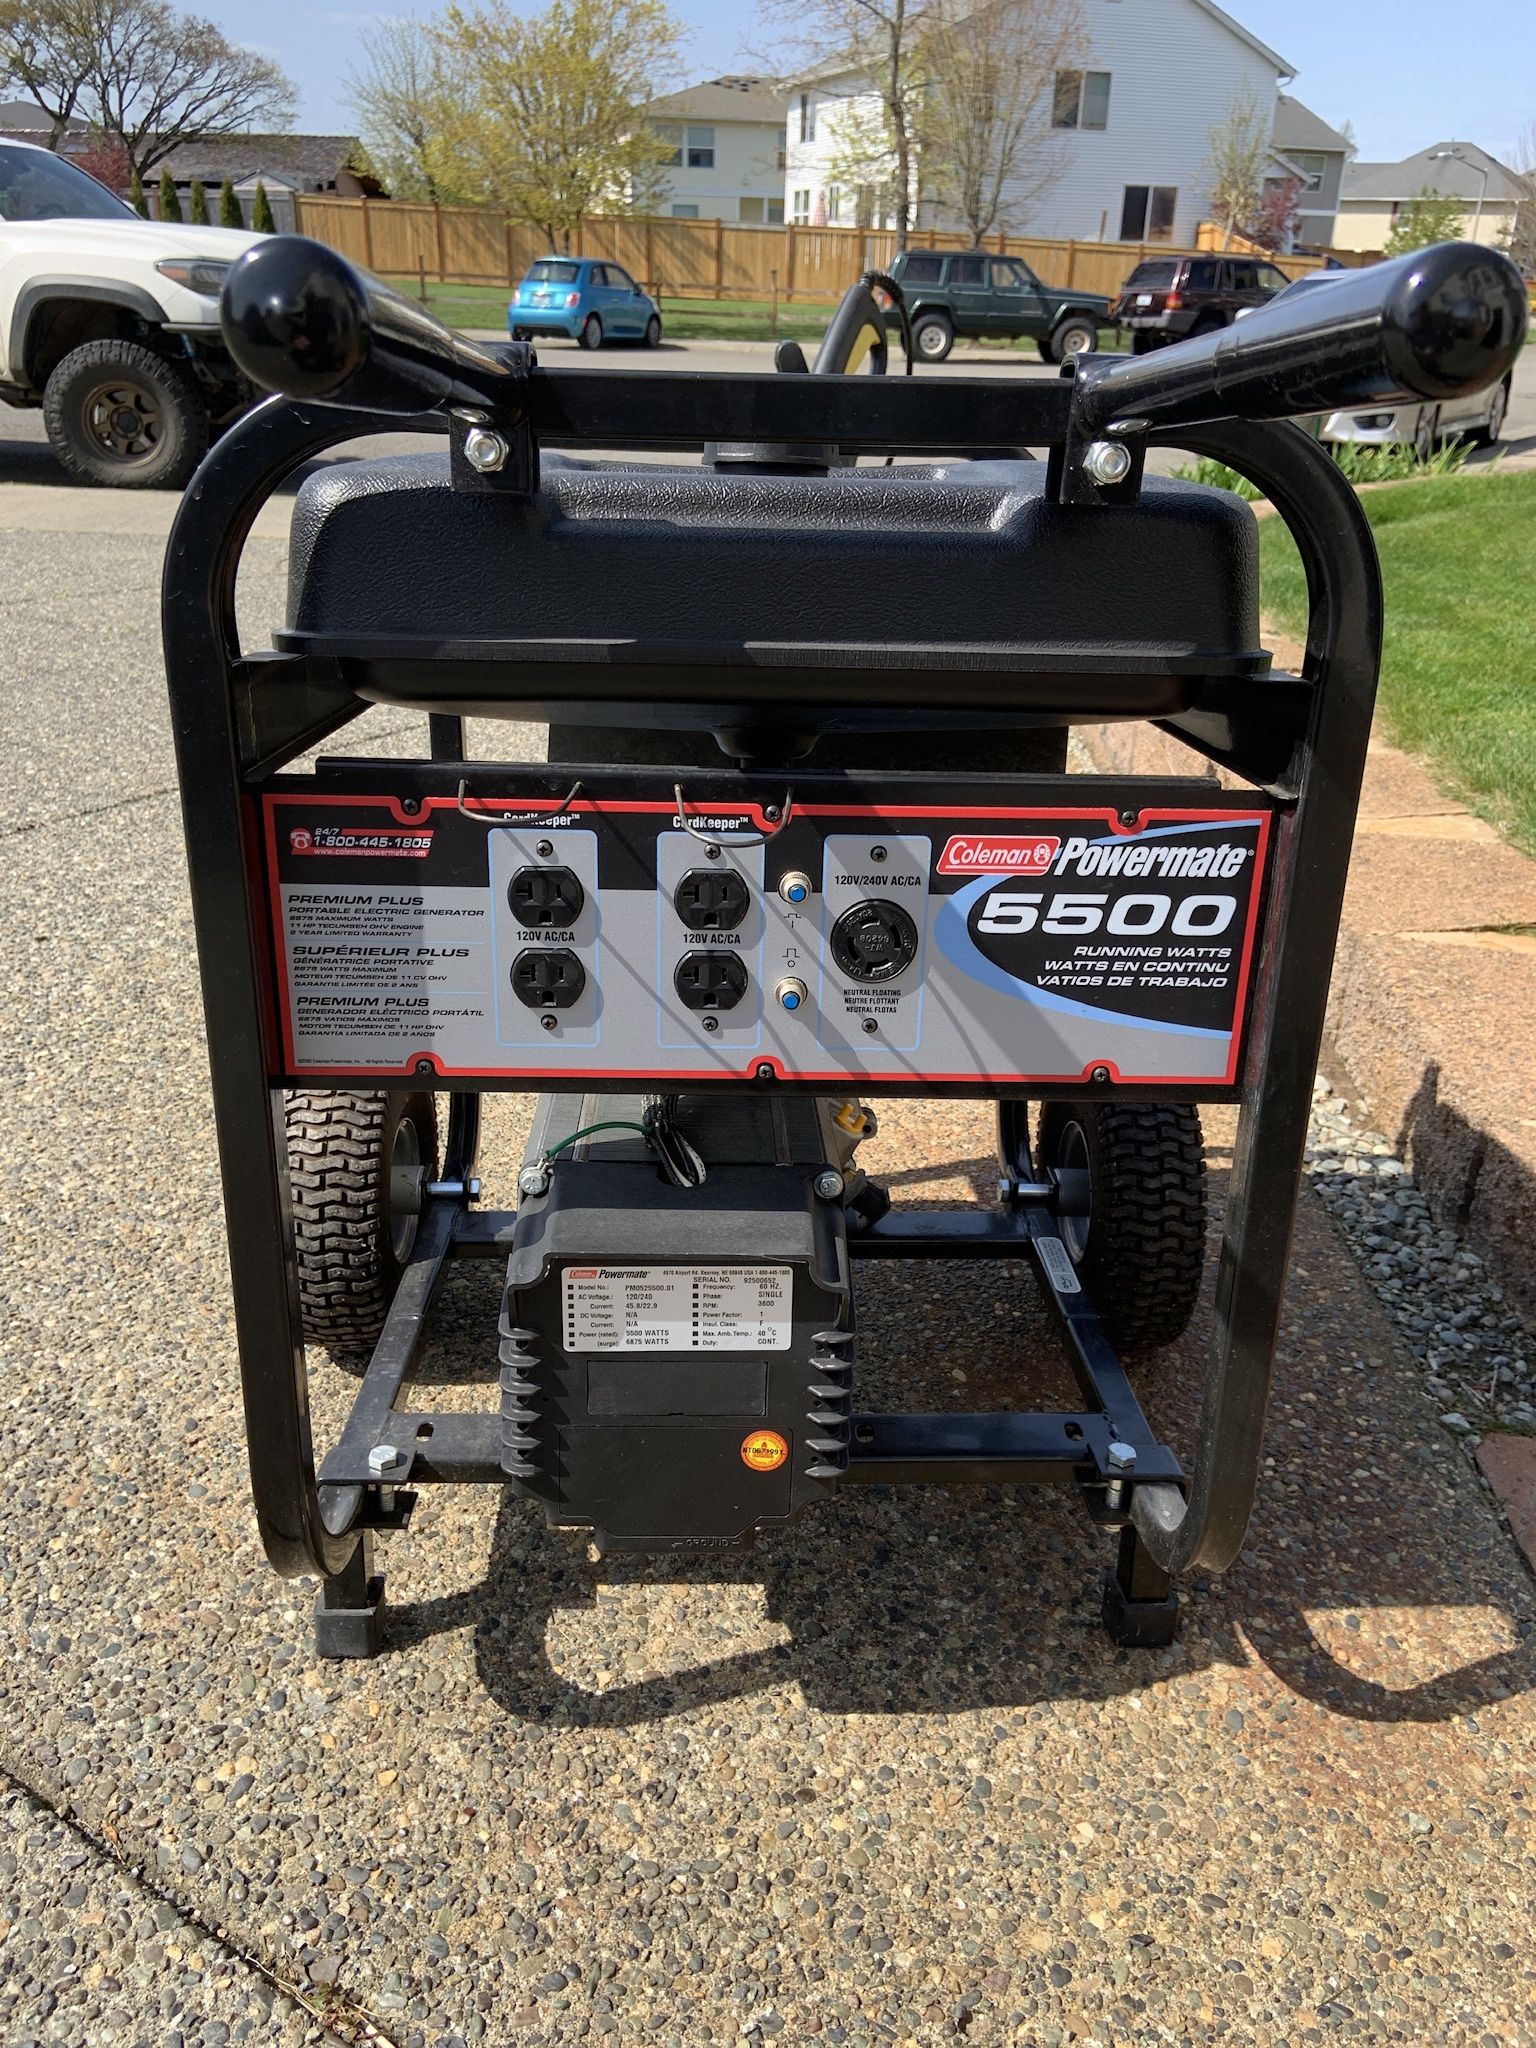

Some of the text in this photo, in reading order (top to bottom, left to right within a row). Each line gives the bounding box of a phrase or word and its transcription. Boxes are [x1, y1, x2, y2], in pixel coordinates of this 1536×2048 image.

[672, 816, 749, 831] CrdKeeper™
[315, 828, 340, 836] 24/7
[314, 849, 426, 858] www.colemanpowermate.com
[949, 841, 1030, 865] Coleman
[835, 875, 921, 886] 120V/240V AC/CA
[288, 895, 424, 906] PREMIUM PLUS
[414, 908, 484, 916] GENERATOR
[977, 893, 1237, 936] 5500
[516, 931, 575, 942] 120V AC/CA
[683, 933, 741, 944] 120V AC/CA
[293, 945, 469, 957] SUPÉRIEUR PLUS
[1073, 946, 1232, 958] RUNNING WATTS
[293, 957, 434, 966] GÉNÉRATRICE PORTATIVE
[1044, 960, 1230, 972] WATTS EN CONTINU
[1036, 975, 1228, 987] VATIOS DE TRABAJO
[297, 997, 430, 1007] PREMIUM PLUS
[369, 1008, 430, 1016] ELÉCTRICO
[432, 1008, 484, 1016] PORTÁTIL
[686, 1539, 728, 1547] GROUND
